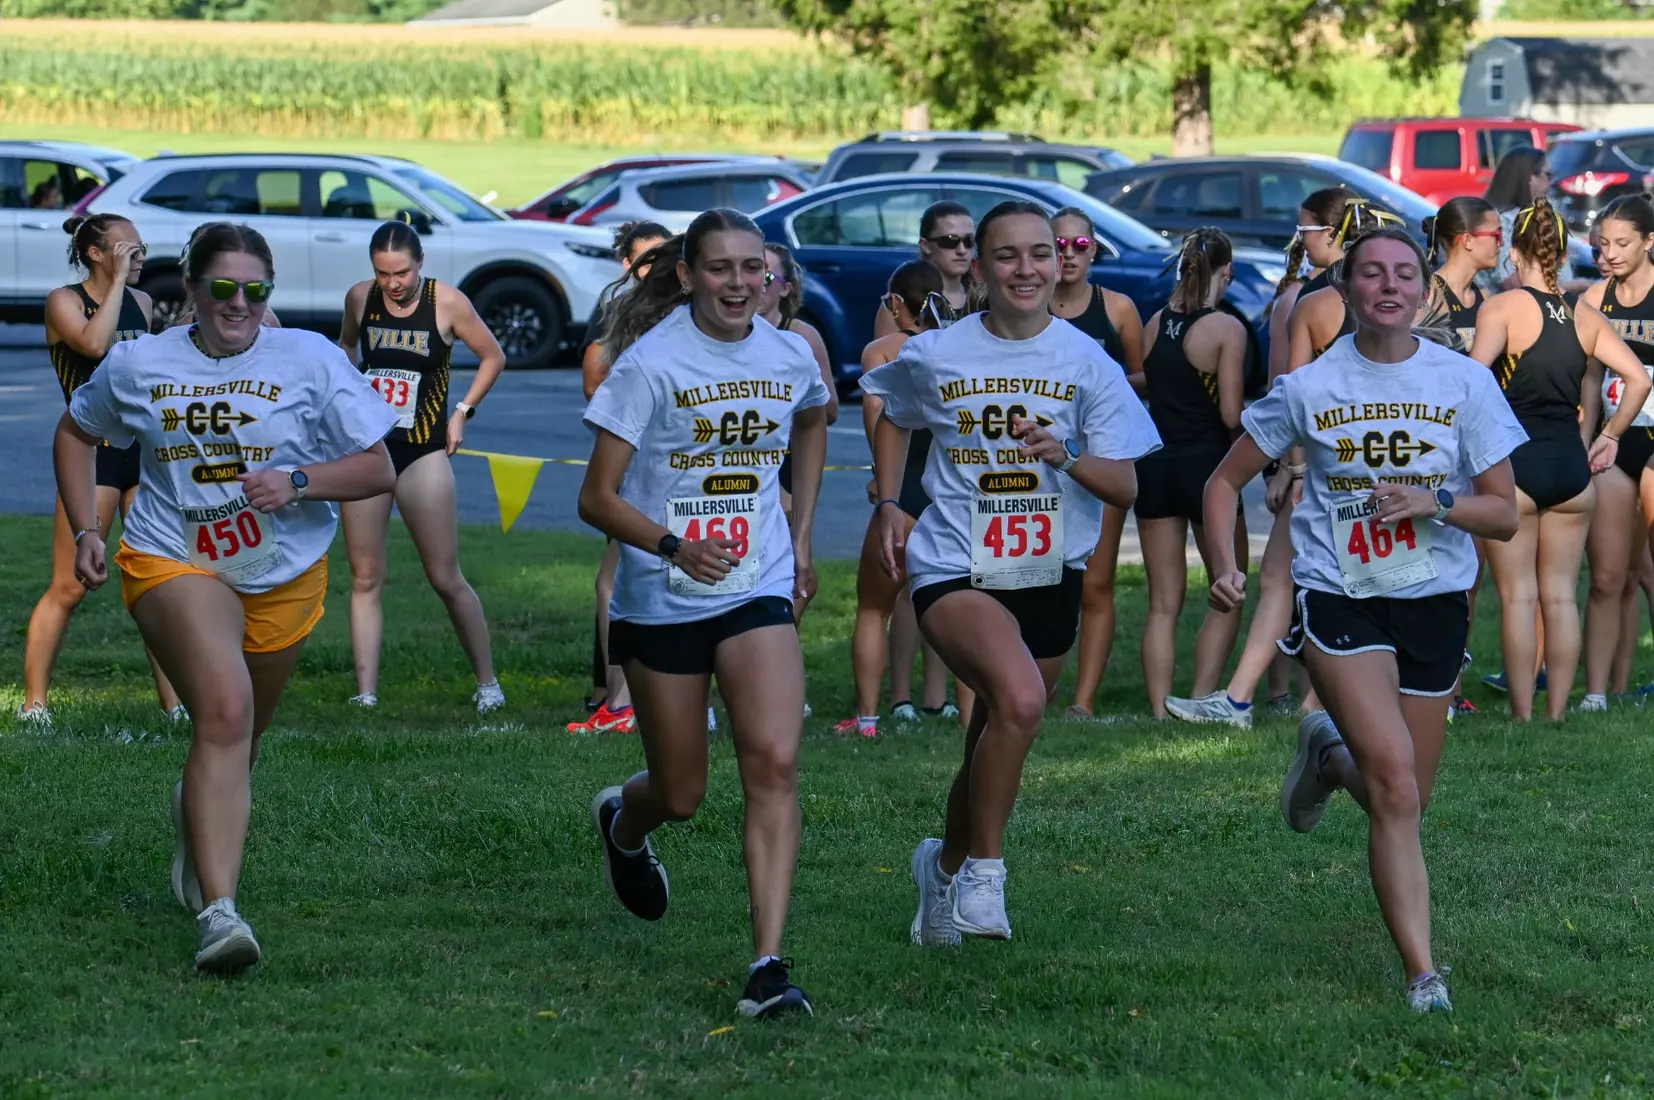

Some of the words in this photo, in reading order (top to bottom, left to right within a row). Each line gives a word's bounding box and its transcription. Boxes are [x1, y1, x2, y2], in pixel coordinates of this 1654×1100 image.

[366, 326, 431, 357] VILLE
[1609, 319, 1654, 346] ILLE
[368, 368, 416, 381] MILLERSVILLE
[149, 379, 282, 404] MILLERSVILLE
[673, 380, 793, 409] MILLERSVILLE
[939, 378, 1077, 402] MILLERSVILLE
[186, 401, 231, 435] CC
[719, 409, 760, 446] CC
[982, 404, 1028, 440] CC
[1313, 402, 1457, 431] MILLERSVILLE
[153, 444, 199, 463] CROSS
[669, 453, 716, 470] CROSS
[1362, 430, 1411, 468] CC
[711, 479, 750, 491] ALUMNI
[987, 477, 1030, 489] ALUMNI
[184, 495, 250, 523] MILLERSVILL
[674, 498, 755, 517] MILLERSVILLE
[978, 497, 1058, 514] MILLERSVILLE
[196, 511, 262, 562] 450
[983, 513, 1051, 558] 453
[1348, 517, 1417, 564] 464
